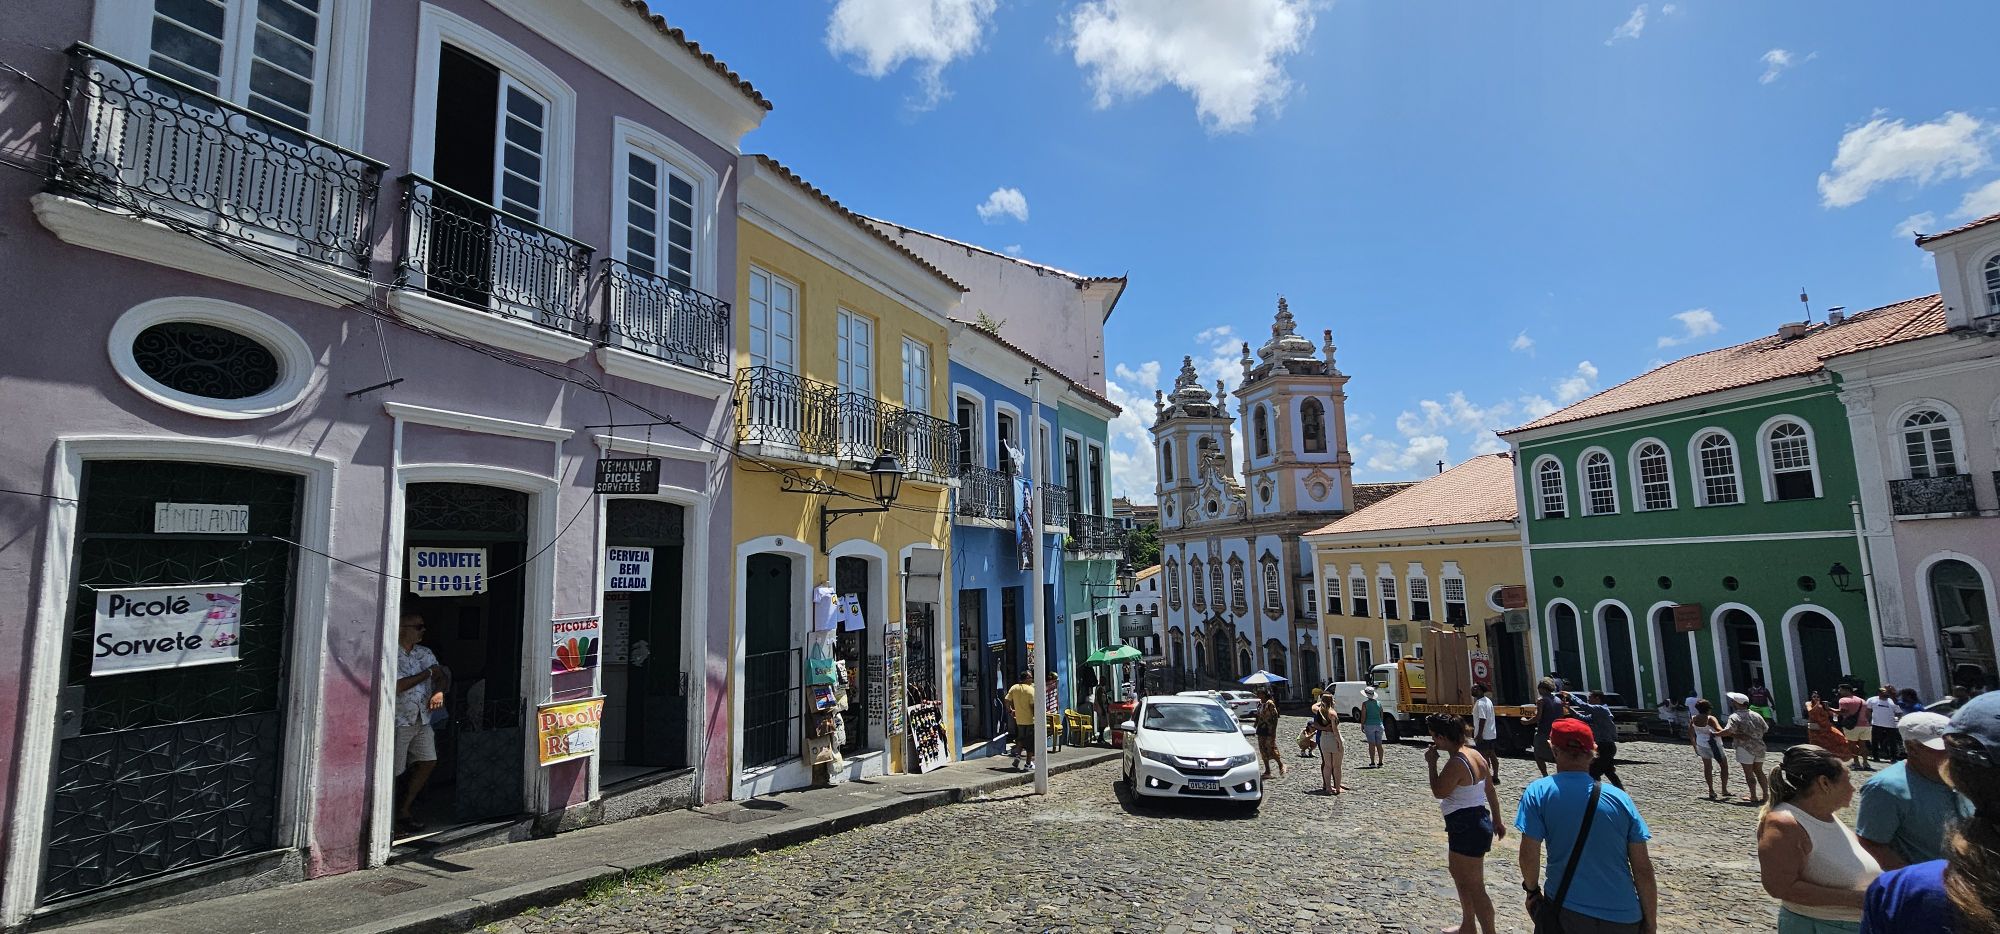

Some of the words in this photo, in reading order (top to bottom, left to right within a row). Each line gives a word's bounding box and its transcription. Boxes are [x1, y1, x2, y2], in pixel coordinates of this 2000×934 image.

[605, 472, 641, 483] PICOLE
[597, 483, 640, 492] SORVETES
[417, 552, 482, 567] SORVETE
[609, 549, 650, 562] CERVEJA
[619, 563, 641, 575] BEM
[417, 573, 482, 591] PICOLÉ
[611, 577, 647, 589] GELADA
[109, 594, 191, 618] Picolé
[554, 618, 599, 633] PICOLÉS
[95, 632, 203, 658] Sorvete
[541, 704, 602, 731] Picolé
